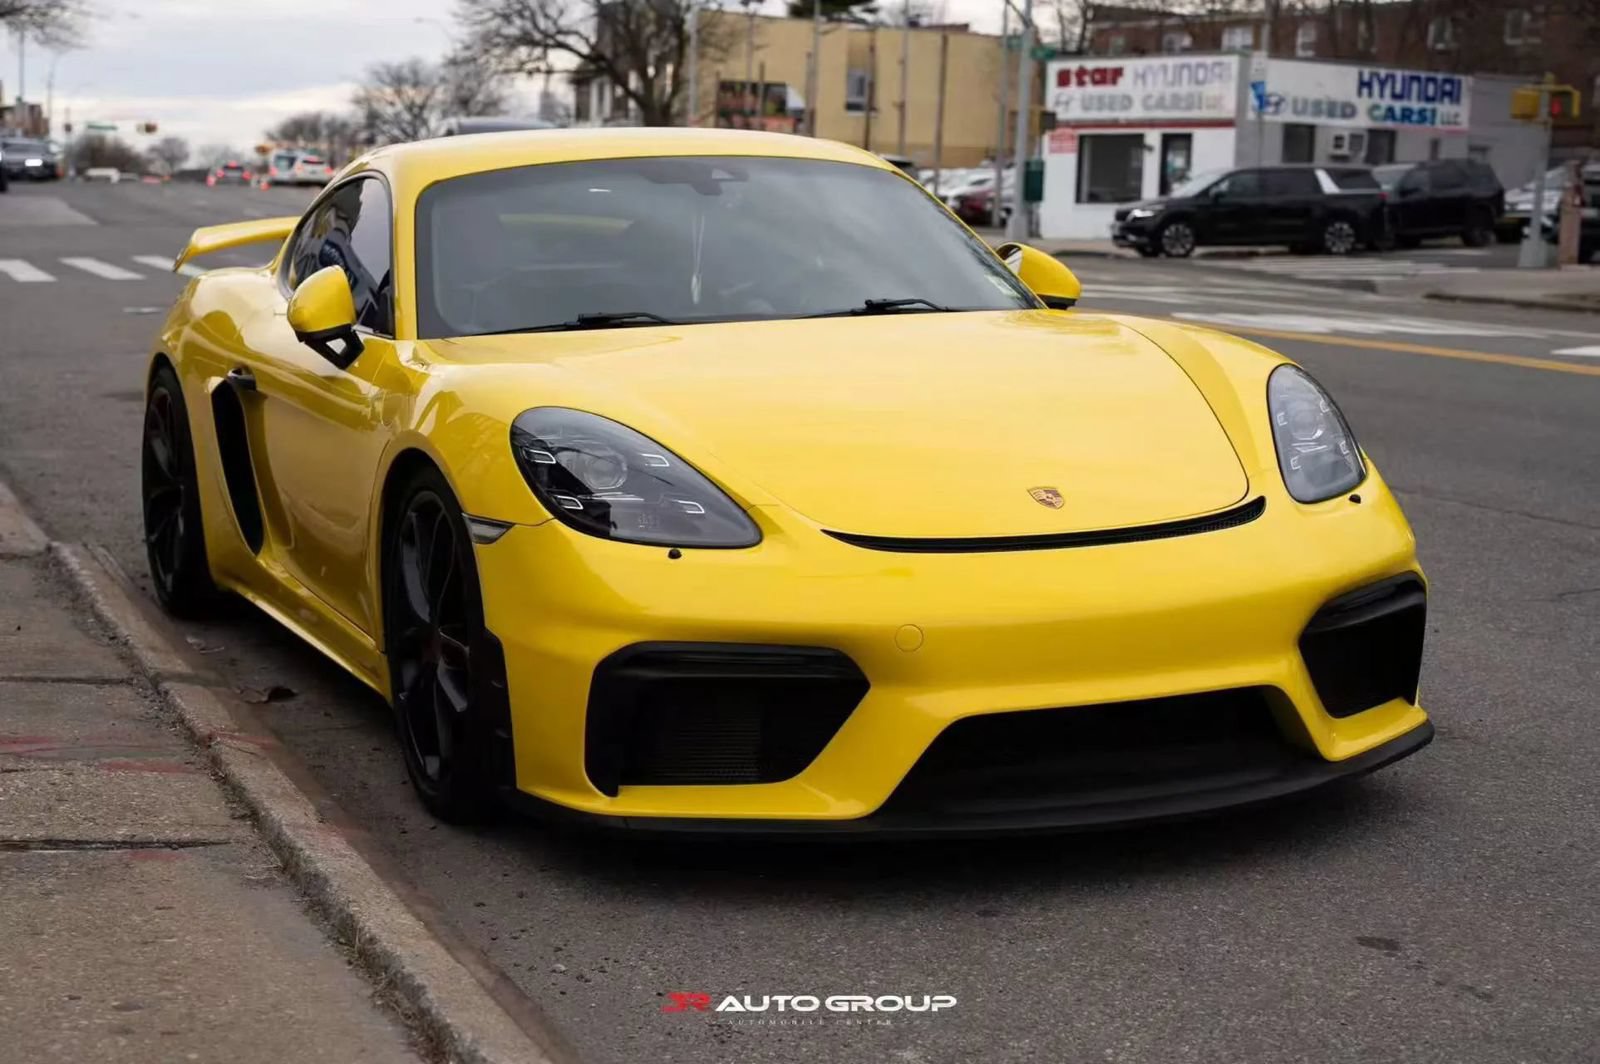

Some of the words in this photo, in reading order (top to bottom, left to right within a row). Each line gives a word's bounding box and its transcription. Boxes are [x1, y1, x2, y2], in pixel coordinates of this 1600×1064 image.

[1057, 65, 1124, 88] star
[1133, 61, 1232, 87] HYUNDAI
[1357, 70, 1462, 105] HYUNDAI
[1081, 93, 1133, 112] USED
[1292, 97, 1357, 119] USED
